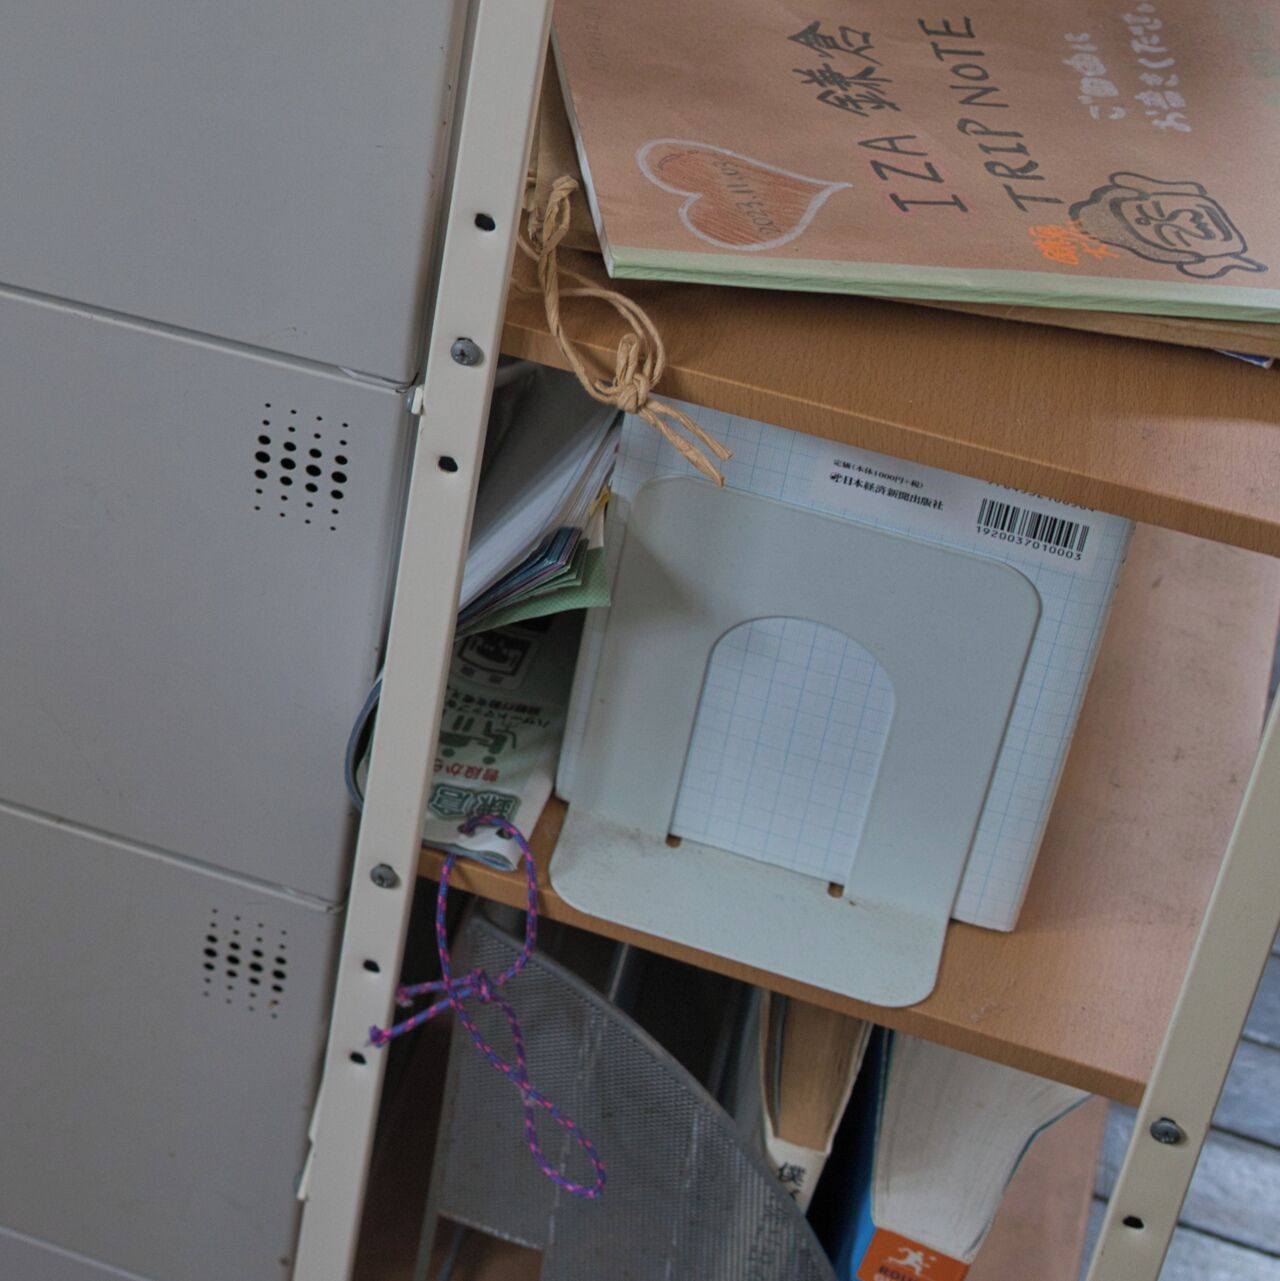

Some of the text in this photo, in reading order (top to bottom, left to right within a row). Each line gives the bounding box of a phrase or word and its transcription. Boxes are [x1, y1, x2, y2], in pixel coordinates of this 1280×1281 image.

[788, 21, 968, 214] IZA 鎌倉
[918, 16, 1063, 212] TRIP NOTE
[843, 475, 944, 511] 日本経済新聞出版社
[976, 525, 1082, 561] 1920037010003
